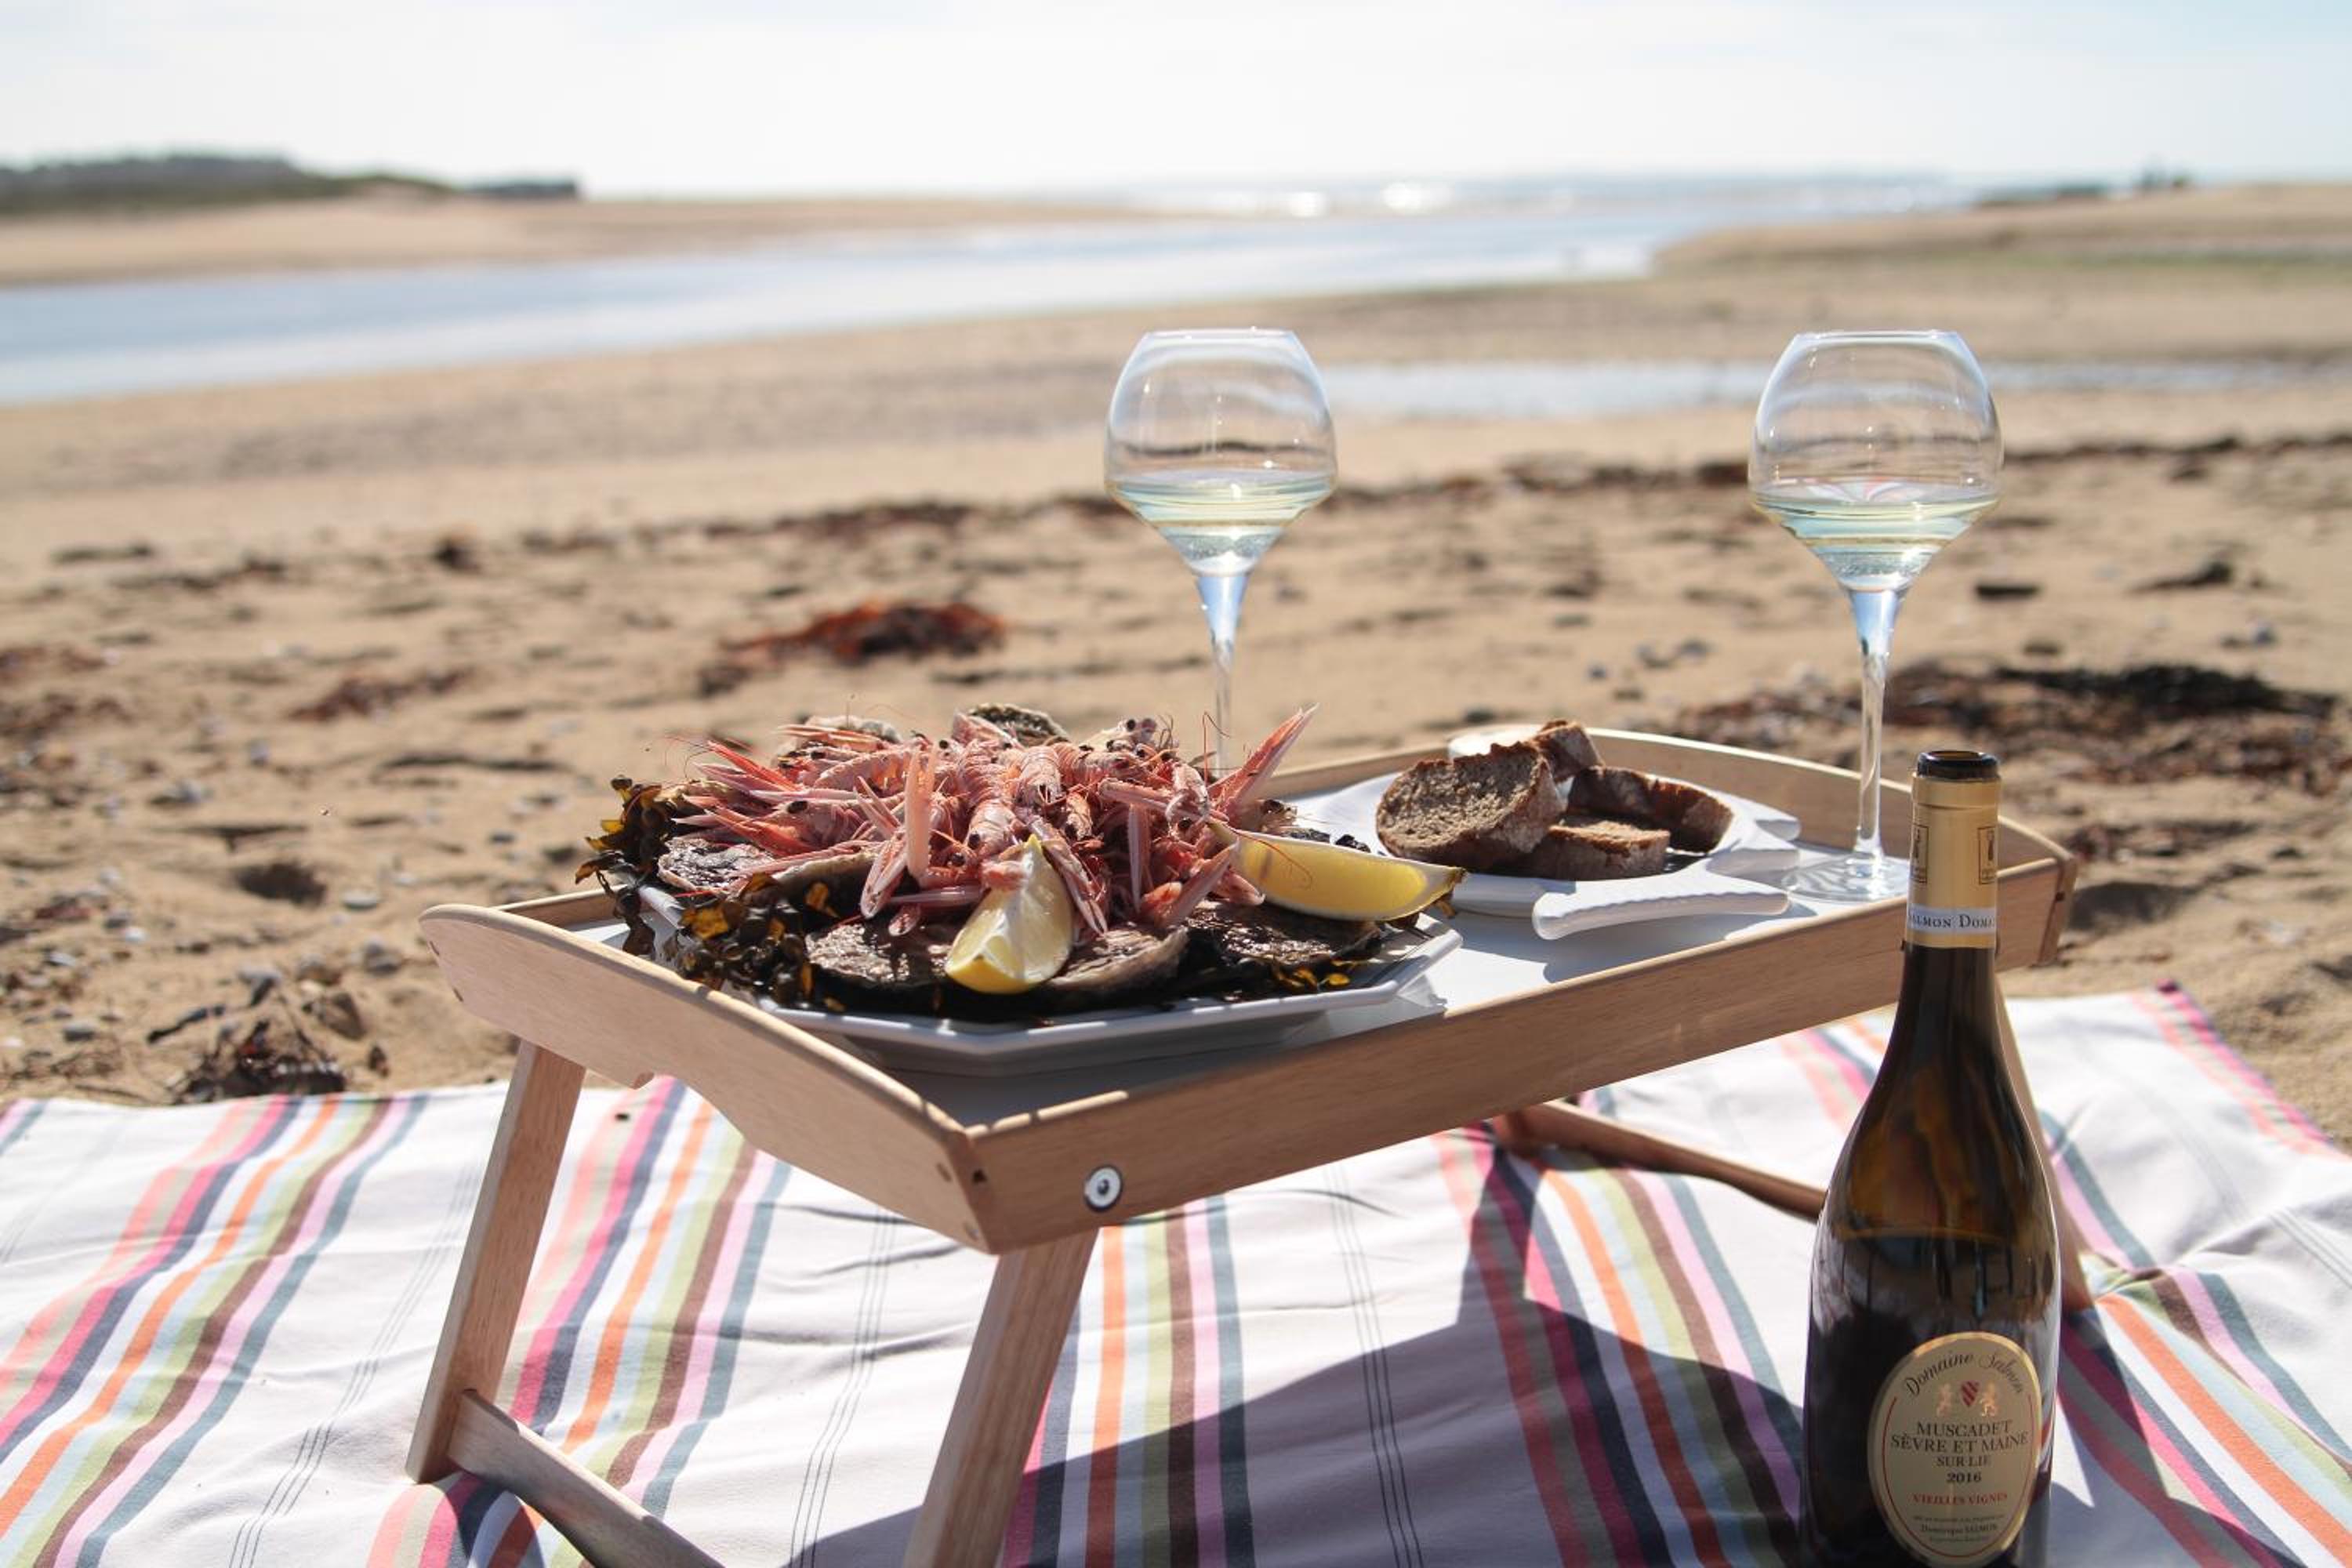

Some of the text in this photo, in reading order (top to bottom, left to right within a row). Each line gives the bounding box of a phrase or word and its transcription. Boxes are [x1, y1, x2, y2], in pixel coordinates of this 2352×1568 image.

[1904, 1350, 1973, 1397] Domaine
[1917, 1421, 2013, 1437] MUSCADET
[1891, 1432, 2028, 1452] SÈVRE ET MAINE
[1936, 1455, 1991, 1467] SUR LIE
[1946, 1472, 1982, 1483] 2016
[1969, 1491, 2008, 1504] VIGNES
